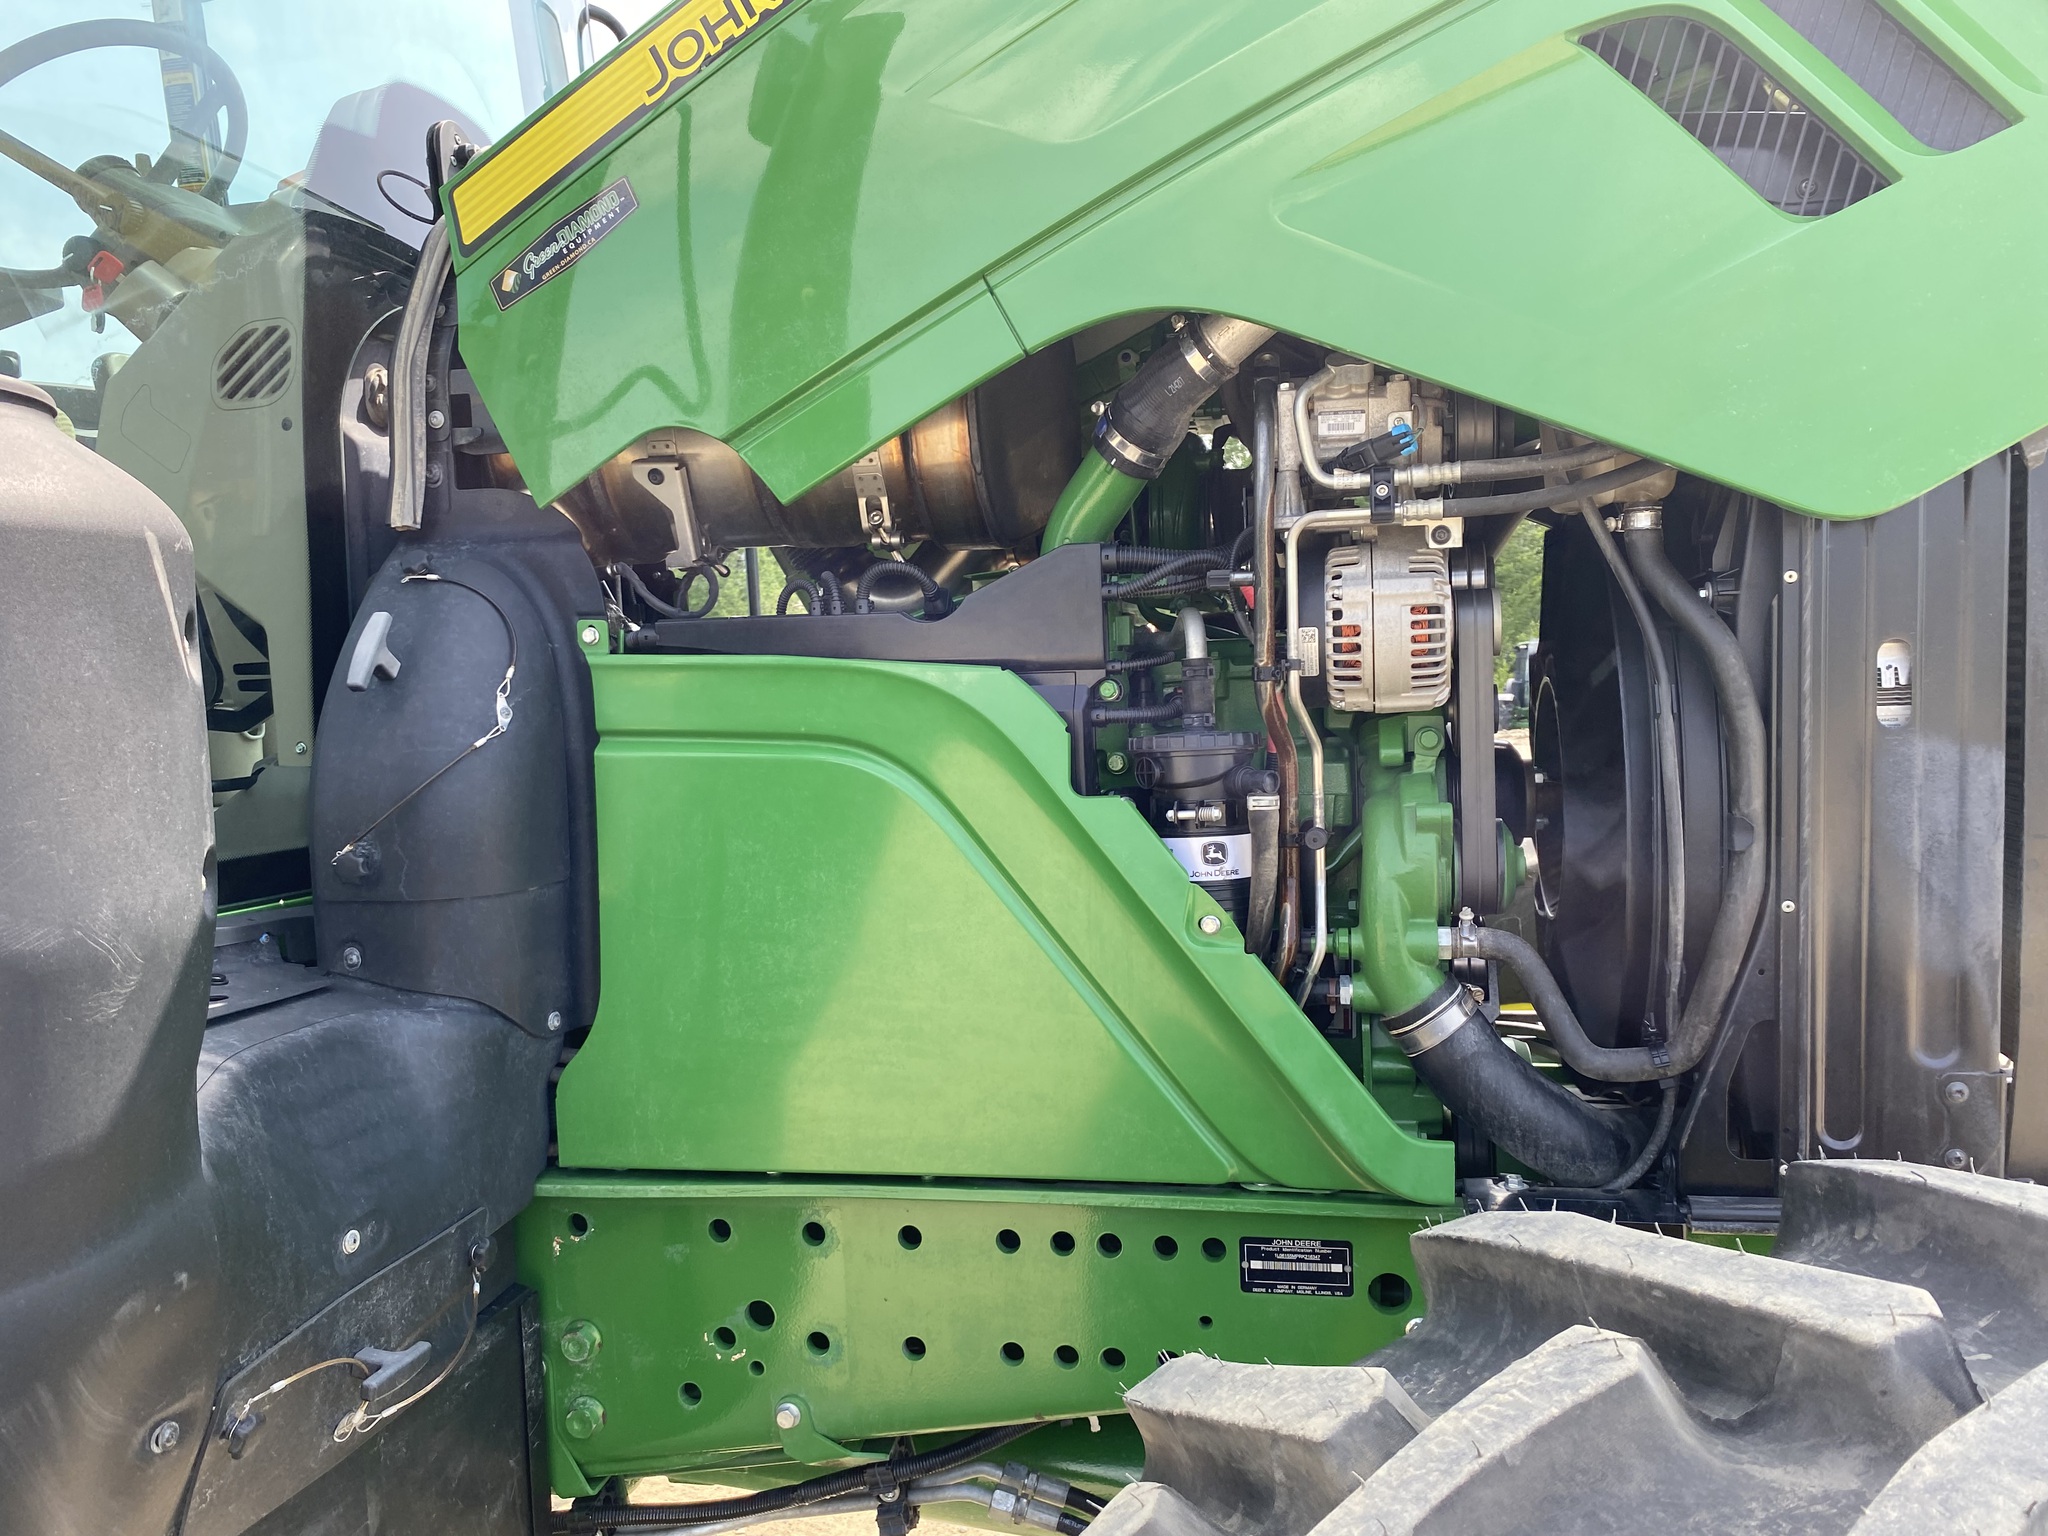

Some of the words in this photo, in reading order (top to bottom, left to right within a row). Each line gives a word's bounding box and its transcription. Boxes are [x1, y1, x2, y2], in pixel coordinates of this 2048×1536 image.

[523, 241, 564, 280] Green
[556, 190, 620, 246] DIAMOND
[562, 206, 621, 254] EQUIPMENT
[541, 237, 597, 280] GREEN-DIAMOND.CA
[1190, 870, 1213, 878] JOHN
[1213, 868, 1239, 877] DEERE
